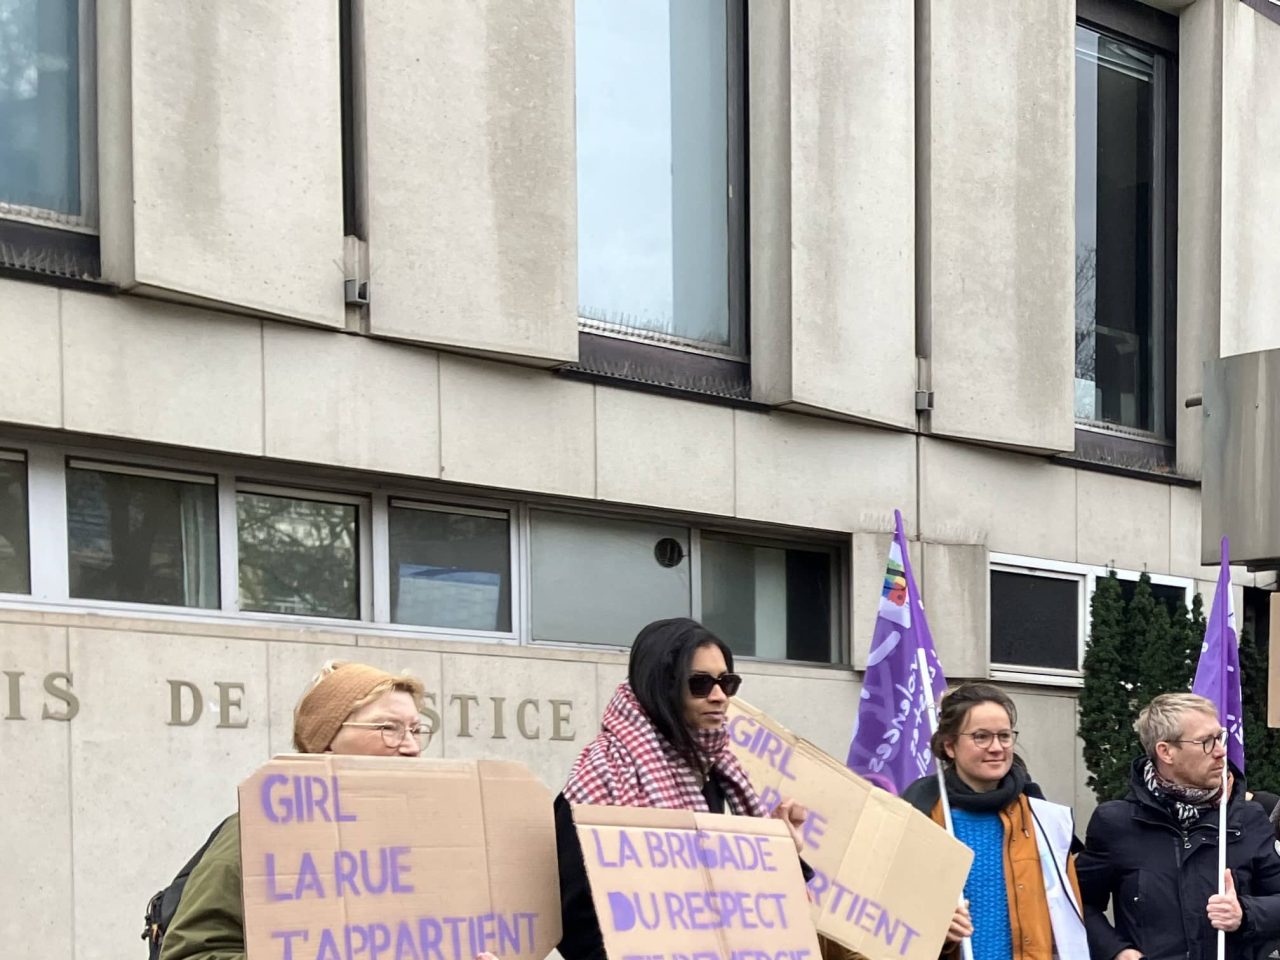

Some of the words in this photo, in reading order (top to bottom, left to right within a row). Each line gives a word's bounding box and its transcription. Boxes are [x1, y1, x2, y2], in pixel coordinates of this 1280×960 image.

[167, 679, 249, 729] DE
[728, 714, 797, 782] GIRL
[261, 773, 358, 824] GIRL
[760, 785, 828, 850] RE
[265, 851, 326, 902] LA
[334, 846, 415, 897] RUE
[591, 827, 642, 869] LA
[644, 829, 778, 872] BRIGADE
[607, 891, 661, 932] DU
[664, 891, 789, 930] RESPECT
